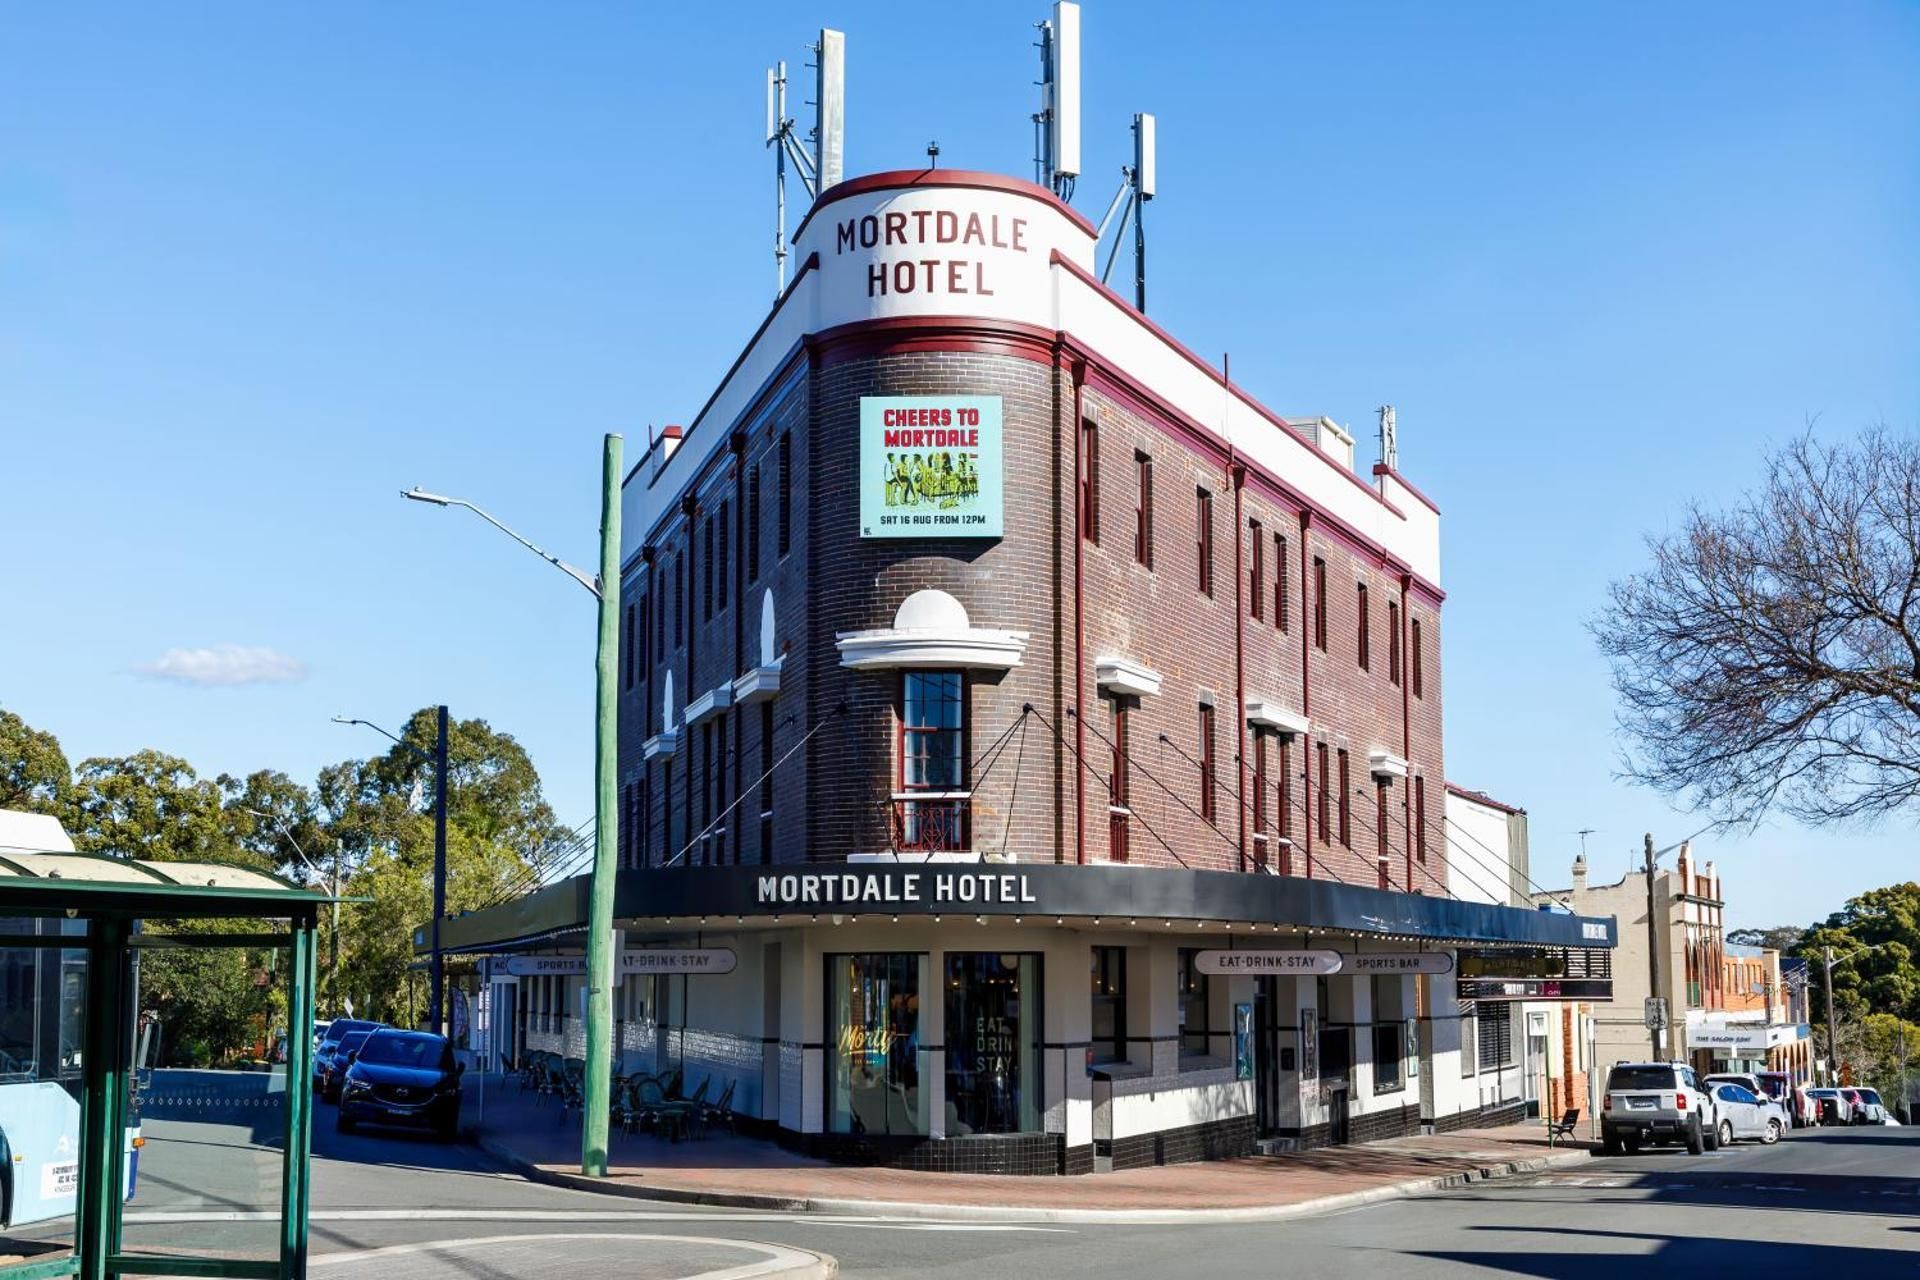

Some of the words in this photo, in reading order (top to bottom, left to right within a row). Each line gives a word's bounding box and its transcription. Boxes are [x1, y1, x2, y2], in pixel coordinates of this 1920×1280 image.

[837, 210, 1027, 254] MORTDALE
[868, 260, 993, 297] HOTEL
[884, 409, 951, 426] CHEERS
[957, 408, 979, 426] TO
[884, 429, 978, 447] MORTDALE
[880, 515, 897, 524] SAT
[900, 515, 910, 524] 16
[913, 515, 931, 524] AUG
[934, 515, 959, 524] FROM
[962, 515, 986, 524] 12PM
[758, 873, 920, 902] MORTDALE
[936, 874, 1036, 902] HOTEL
[537, 960, 574, 970] SPORTS
[1356, 959, 1396, 969] SPORTS
[1399, 959, 1420, 969] BAR
[977, 1017, 1005, 1033] EAT
[977, 1056, 1012, 1072] STAY
